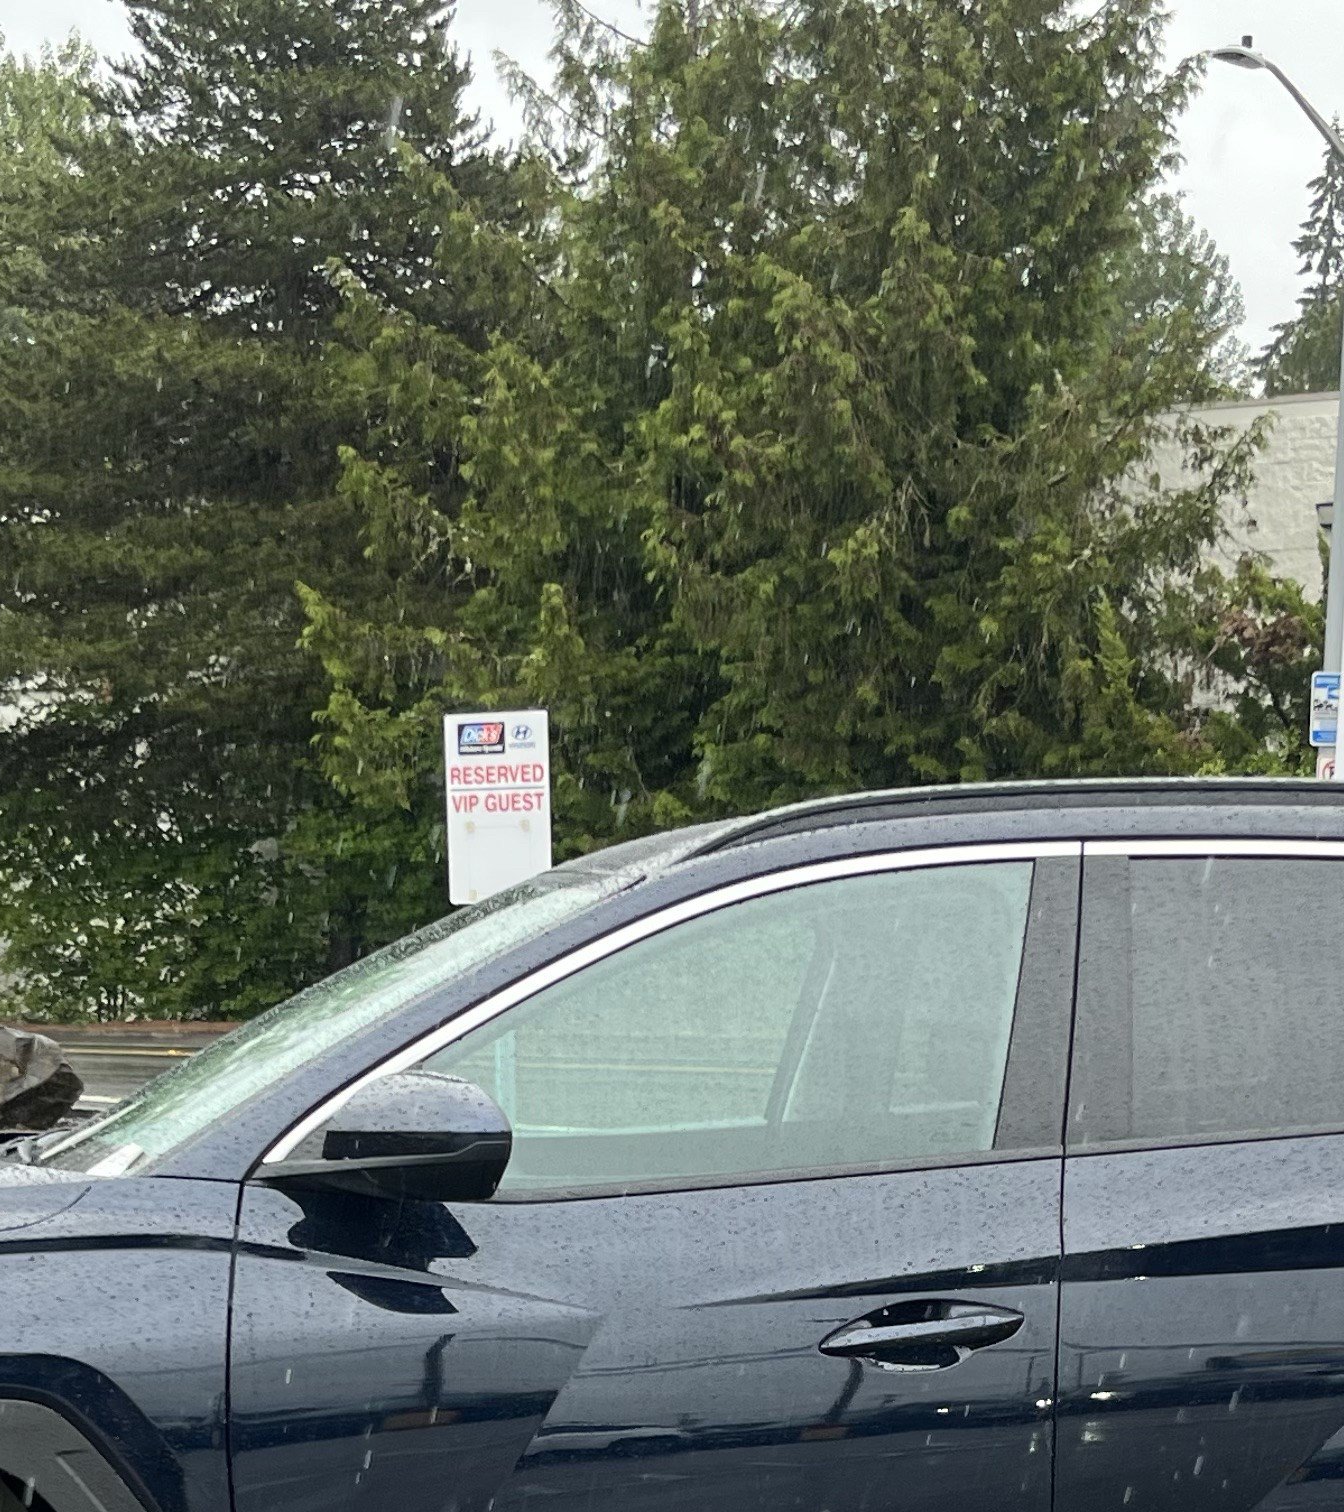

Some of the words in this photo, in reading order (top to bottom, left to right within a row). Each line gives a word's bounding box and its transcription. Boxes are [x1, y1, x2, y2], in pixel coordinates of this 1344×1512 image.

[450, 764, 544, 785] RESERVED
[452, 795, 479, 813] VIP
[485, 793, 544, 812] GUEST
